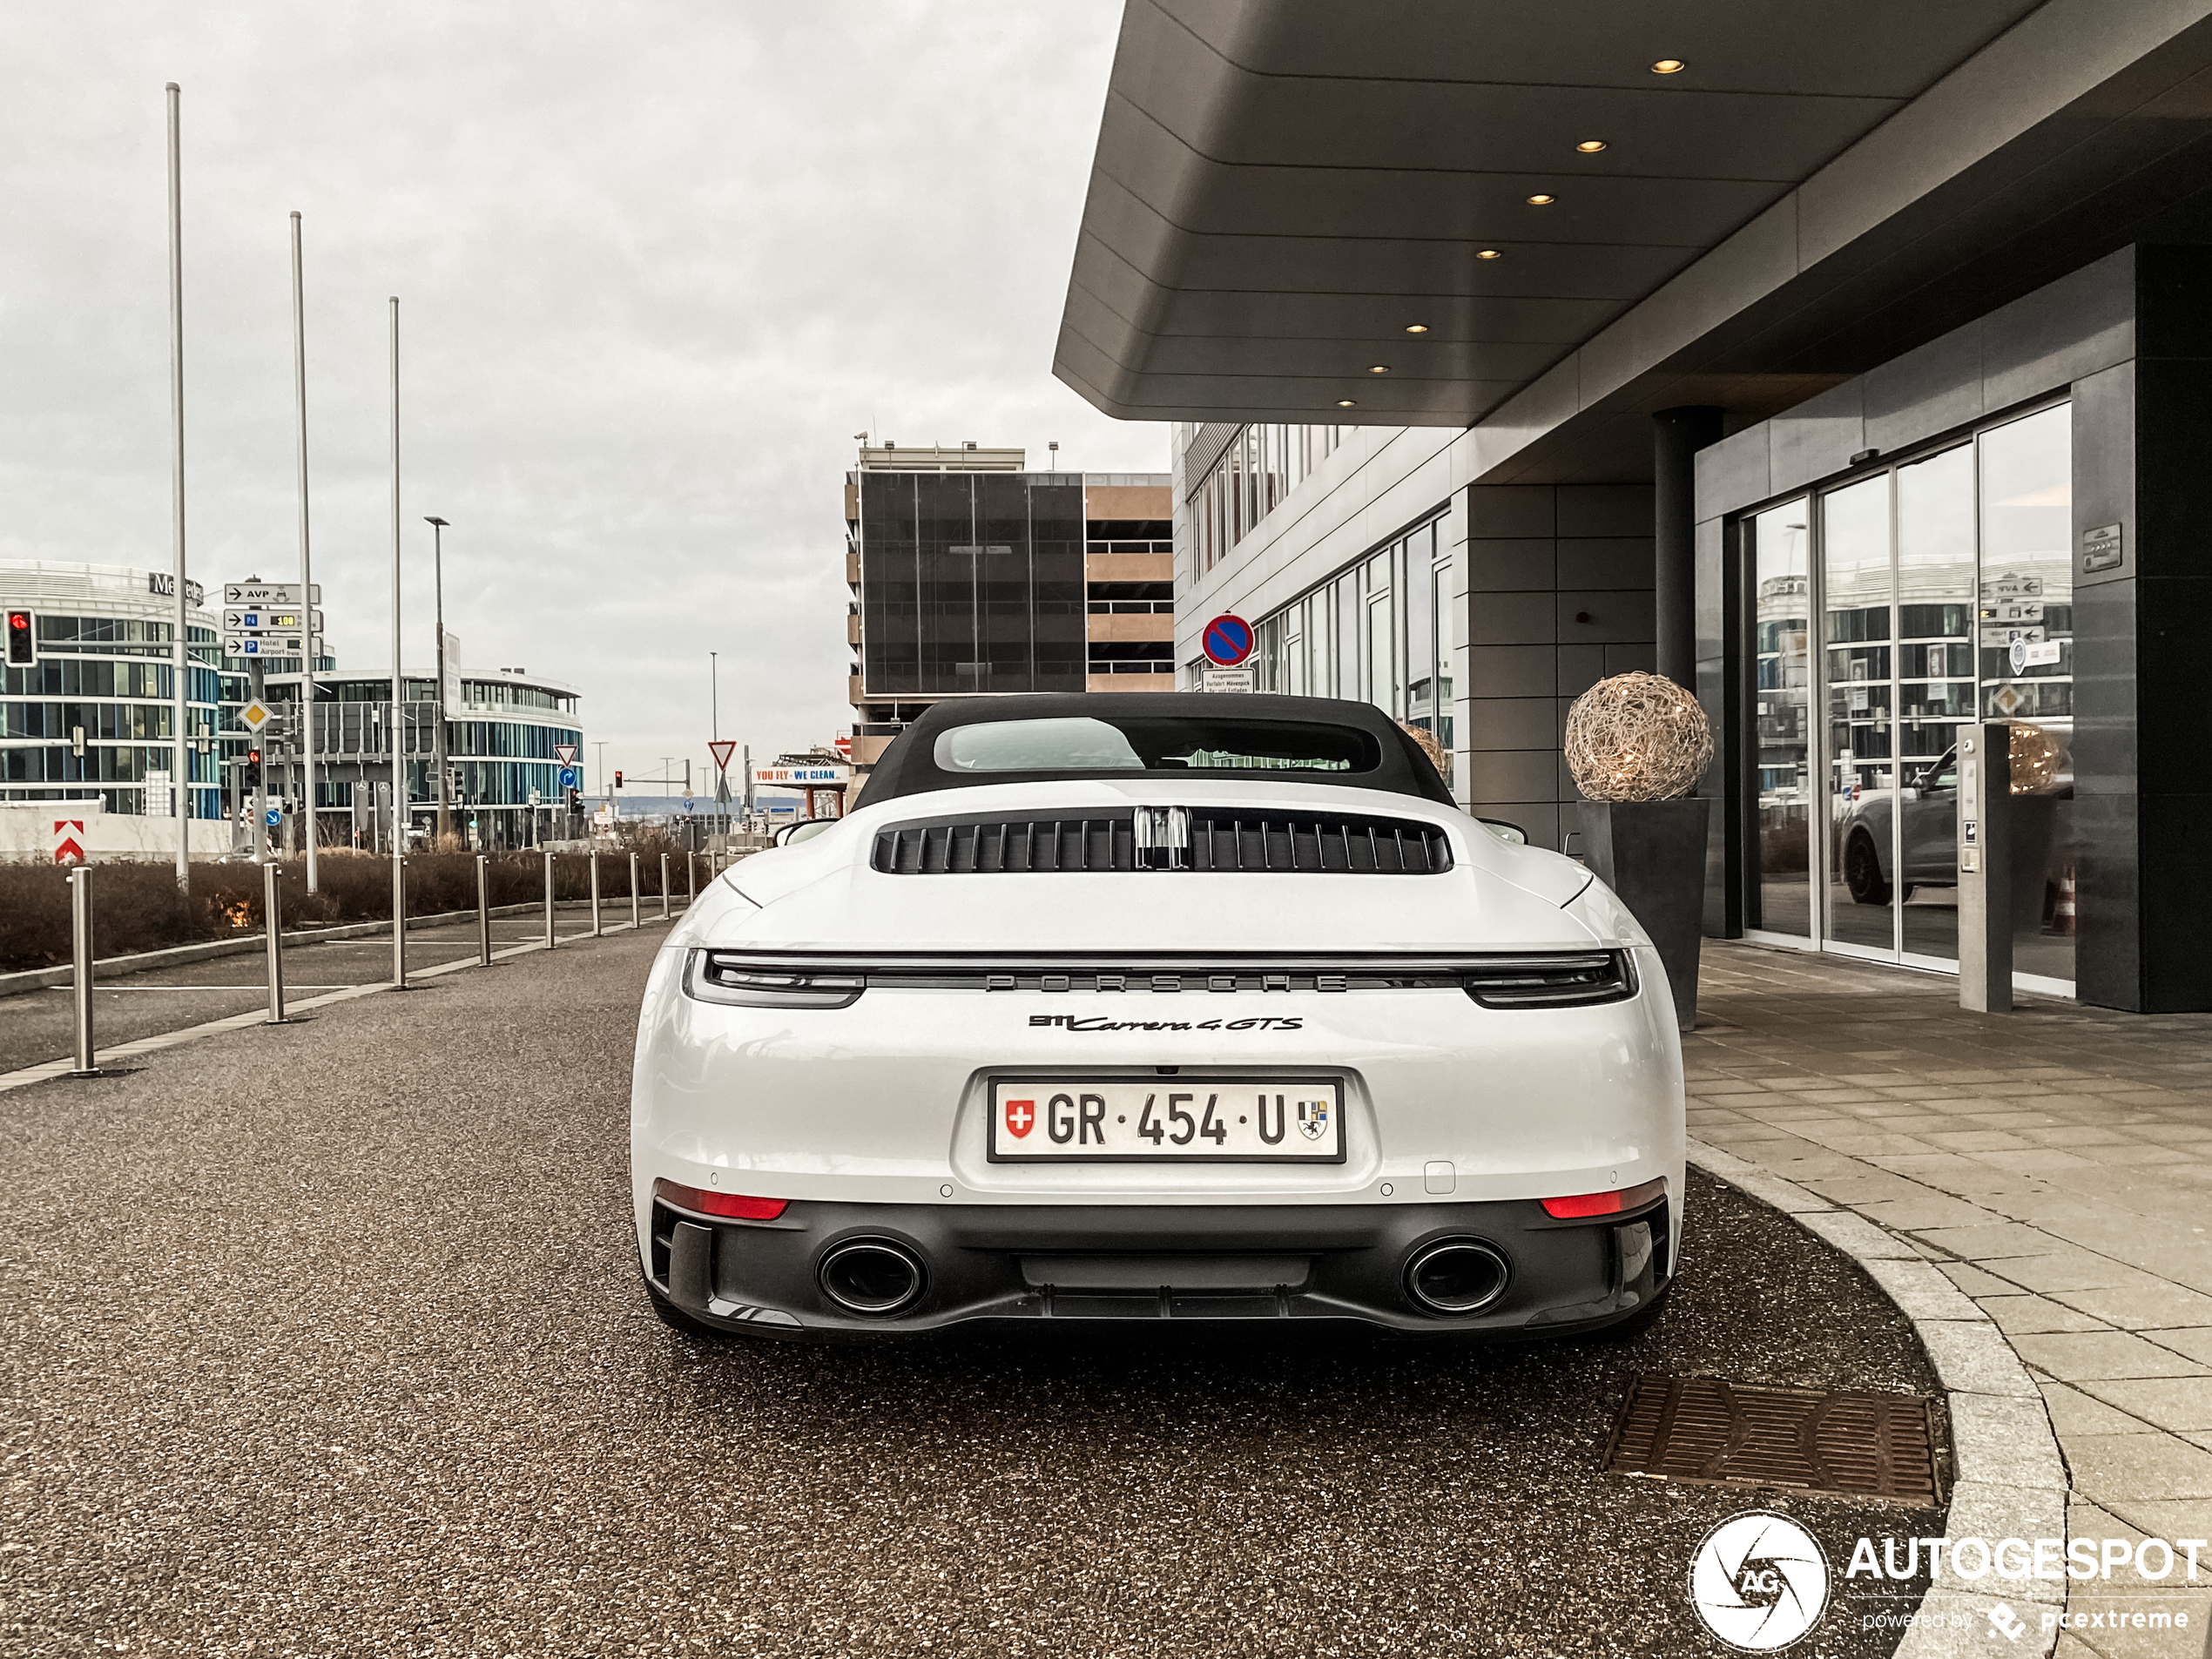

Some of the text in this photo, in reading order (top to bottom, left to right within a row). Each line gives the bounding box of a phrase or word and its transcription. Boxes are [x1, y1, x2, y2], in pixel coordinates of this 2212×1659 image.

[247, 642, 255, 652] P
[757, 771, 773, 780] YOU
[776, 771, 789, 780] FLY
[794, 771, 807, 780] WE
[810, 770, 835, 779] CLEAN
[986, 974, 1347, 993] PORSCHE
[1066, 1016, 1193, 1032] Carrera
[1225, 1017, 1304, 1030] GTS
